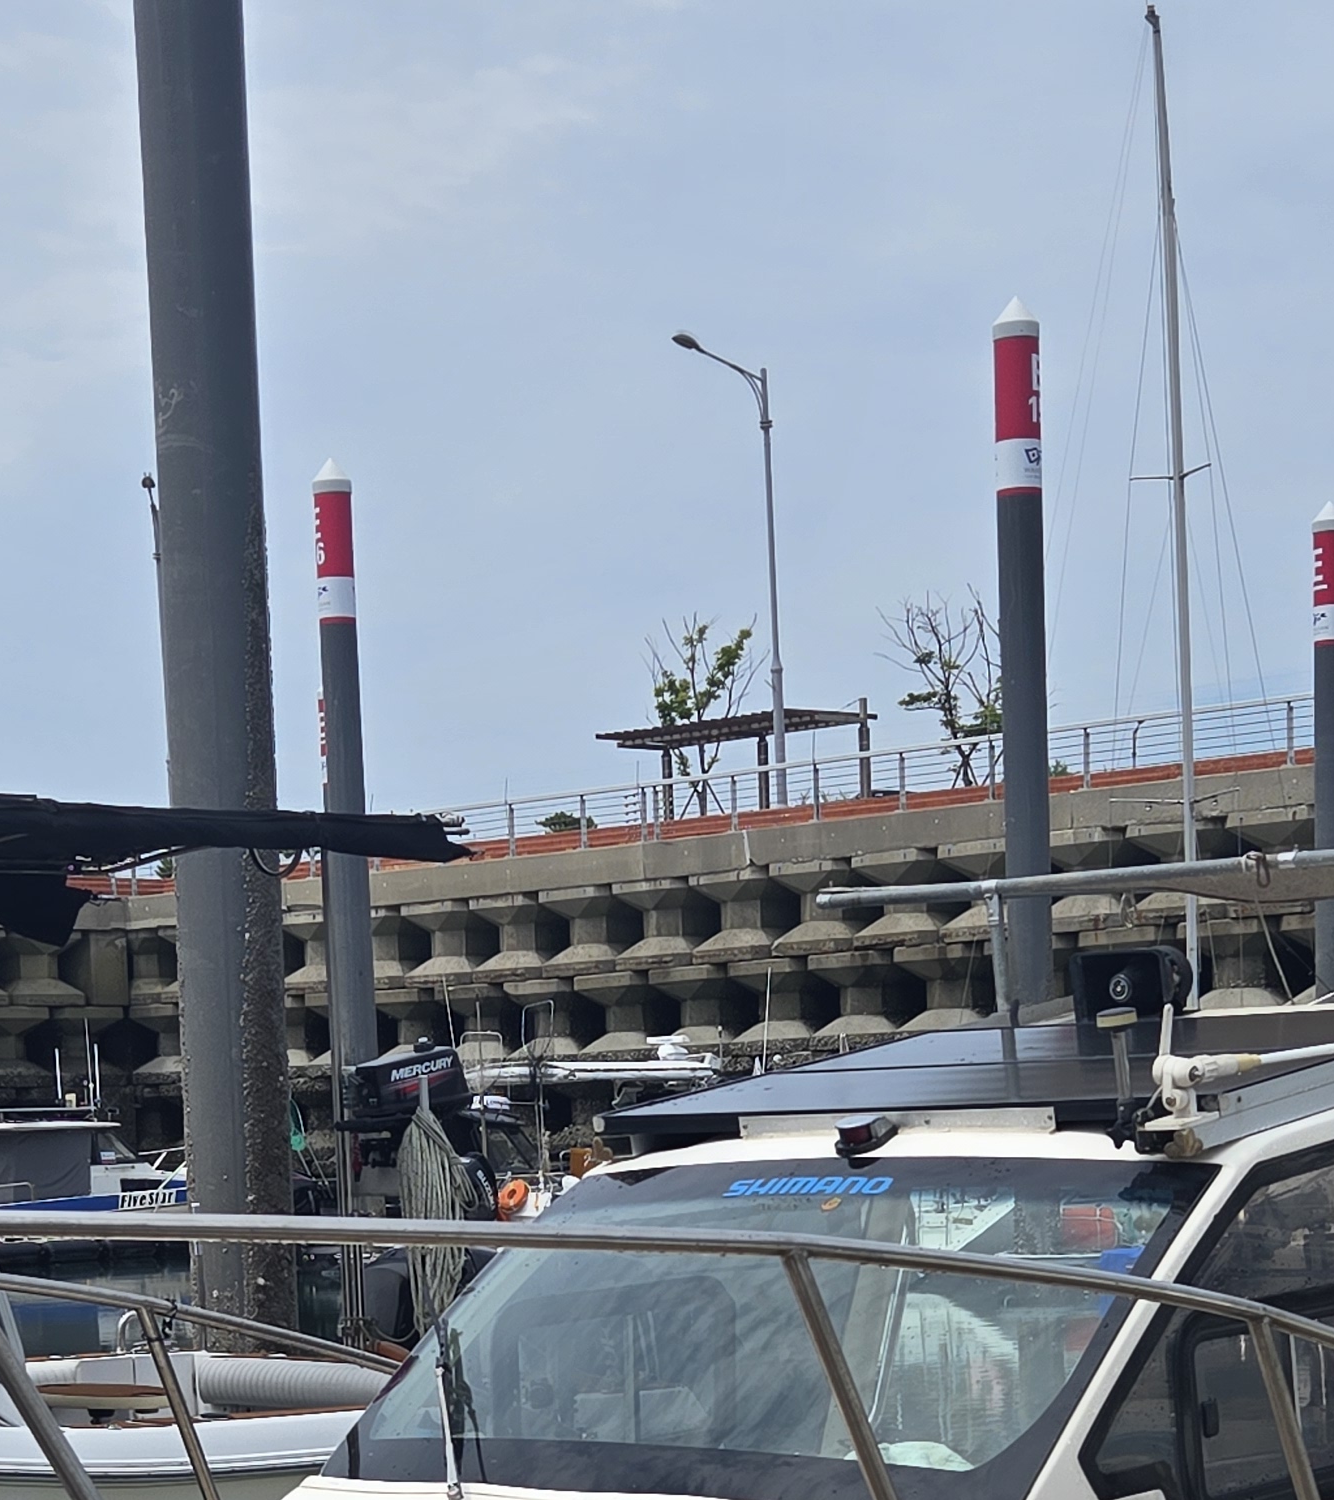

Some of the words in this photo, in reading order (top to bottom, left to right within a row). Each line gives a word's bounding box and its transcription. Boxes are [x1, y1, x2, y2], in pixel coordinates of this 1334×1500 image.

[390, 1055, 454, 1082] MERCURY
[722, 1175, 895, 1198] SHIMANO
[120, 1194, 147, 1209] Five
